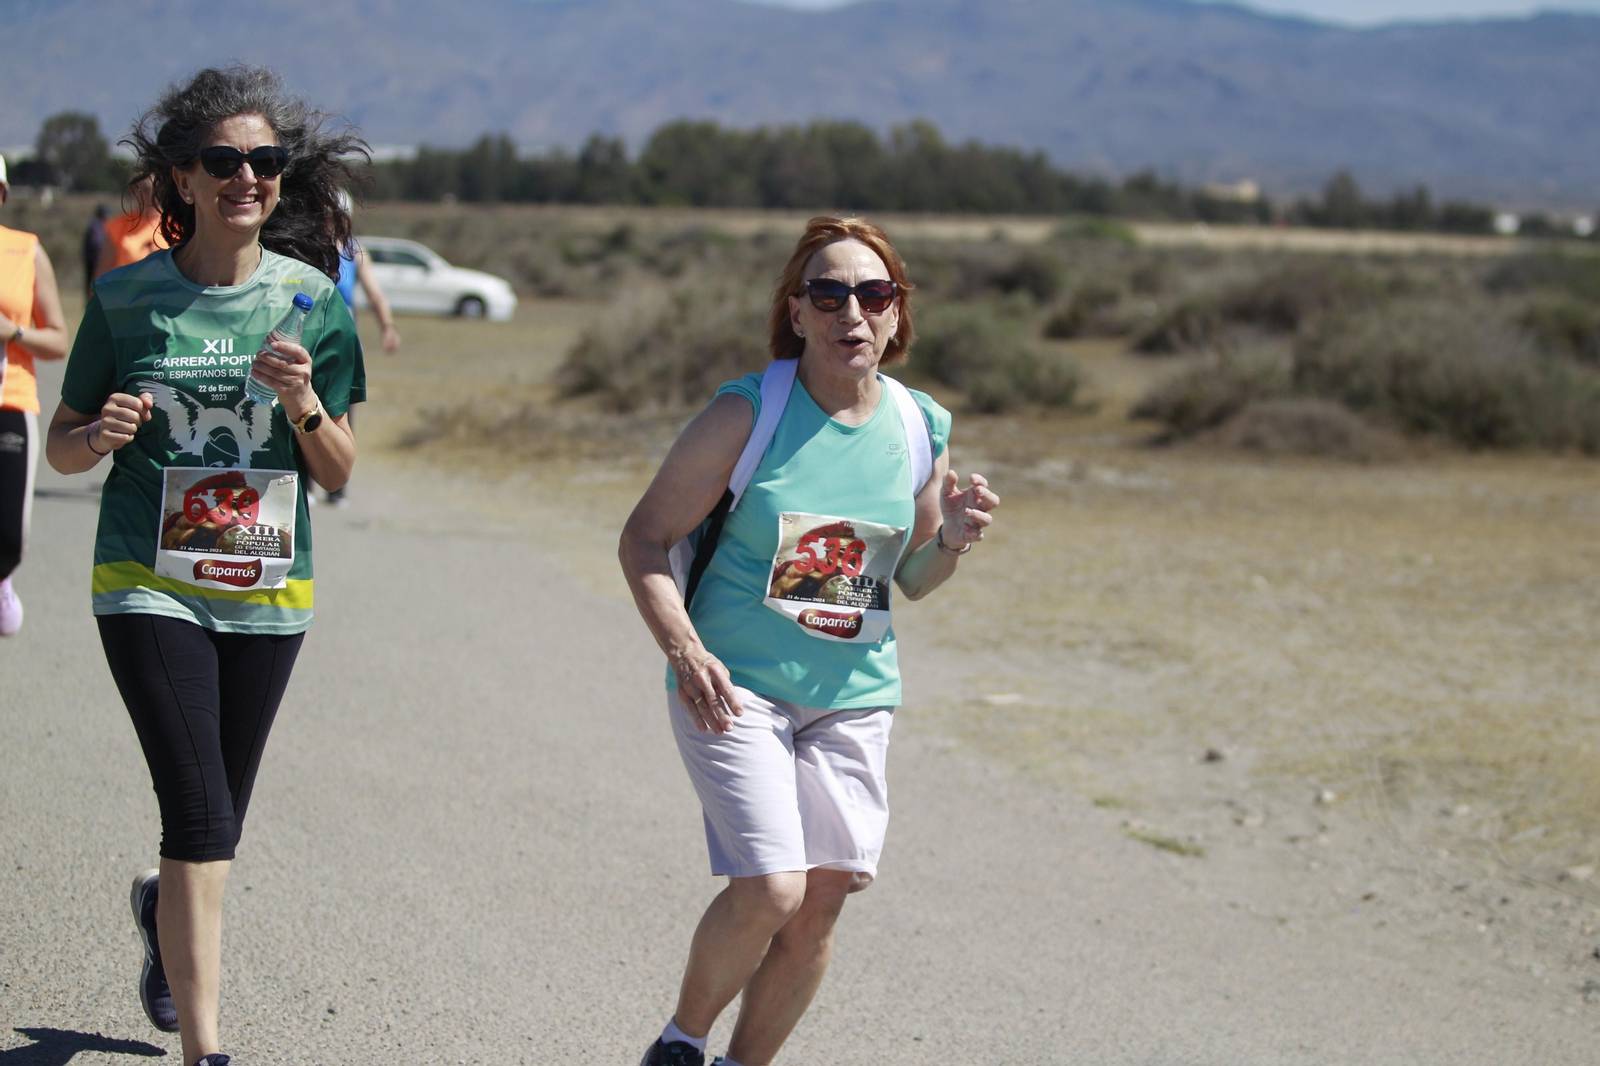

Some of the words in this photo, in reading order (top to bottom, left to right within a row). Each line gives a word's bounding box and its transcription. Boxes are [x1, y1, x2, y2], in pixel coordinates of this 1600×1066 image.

[202, 338, 234, 354] XII
[153, 356, 218, 370] CARRERA
[152, 371, 167, 380] CD.
[169, 369, 227, 380] ESPARTANOS
[229, 368, 246, 377] DEL
[198, 385, 207, 393] 22
[208, 384, 217, 392] de
[218, 384, 239, 392] Enero
[183, 487, 260, 526] 639
[236, 524, 281, 537] XIII
[793, 534, 866, 578] 536
[838, 574, 879, 588] XIII
[837, 585, 879, 594] CARRERA
[838, 590, 878, 599] POPULAR
